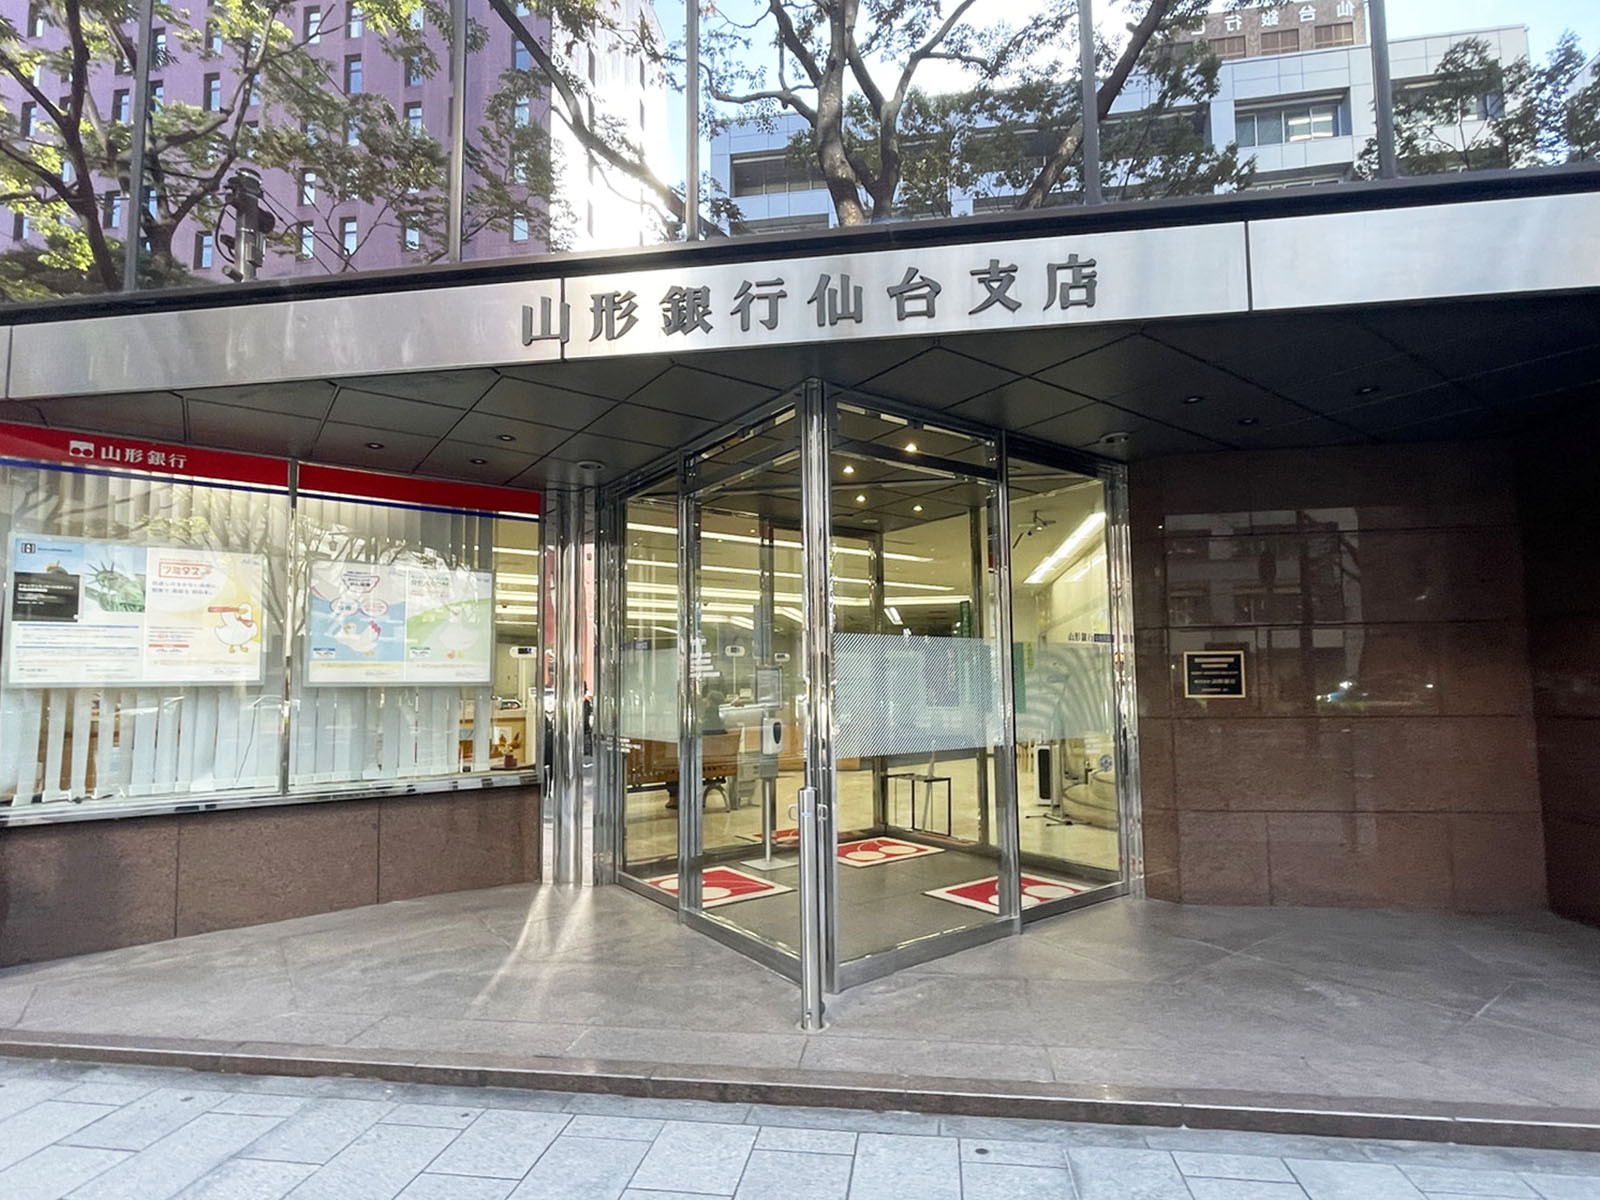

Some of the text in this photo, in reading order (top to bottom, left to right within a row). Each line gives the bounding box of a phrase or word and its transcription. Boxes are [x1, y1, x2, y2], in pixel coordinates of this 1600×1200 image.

[521, 252, 1098, 347] 山形銀行仙台支店
[100, 446, 187, 468] 山形銀行
